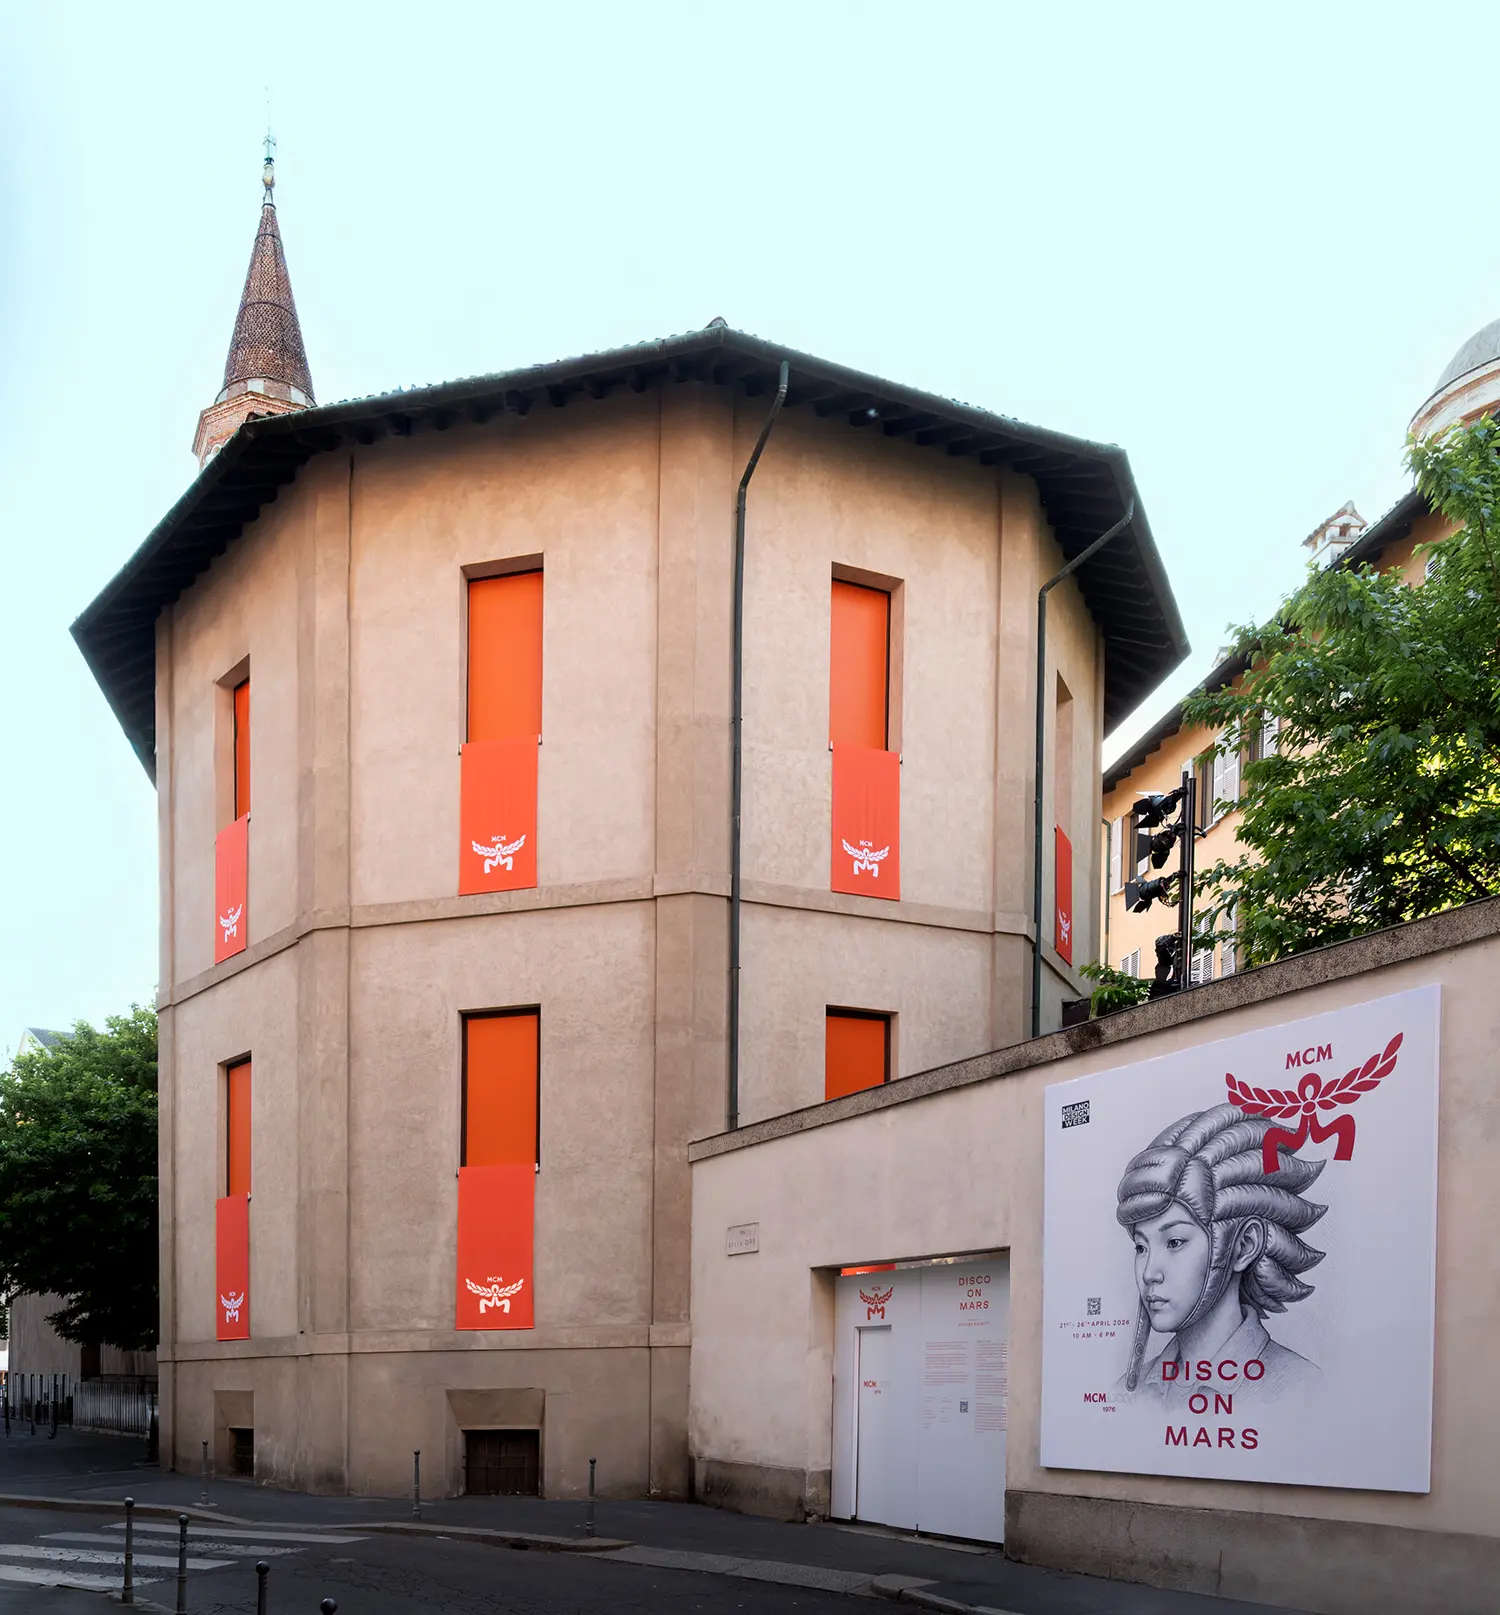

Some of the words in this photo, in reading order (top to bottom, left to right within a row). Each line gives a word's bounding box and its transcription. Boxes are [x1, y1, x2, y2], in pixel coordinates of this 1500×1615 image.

[1285, 1043, 1333, 1070] MCM
[1062, 1102, 1089, 1114] MILANO
[1064, 1110, 1088, 1121] DESIGN
[1064, 1116, 1088, 1127] WEEK
[958, 1275, 991, 1286] DISCO
[967, 1289, 982, 1297] ON
[960, 1300, 989, 1310] MARS
[1162, 1359, 1265, 1381] DISCO
[1188, 1393, 1233, 1415] ON
[1165, 1425, 1259, 1450] MARS
